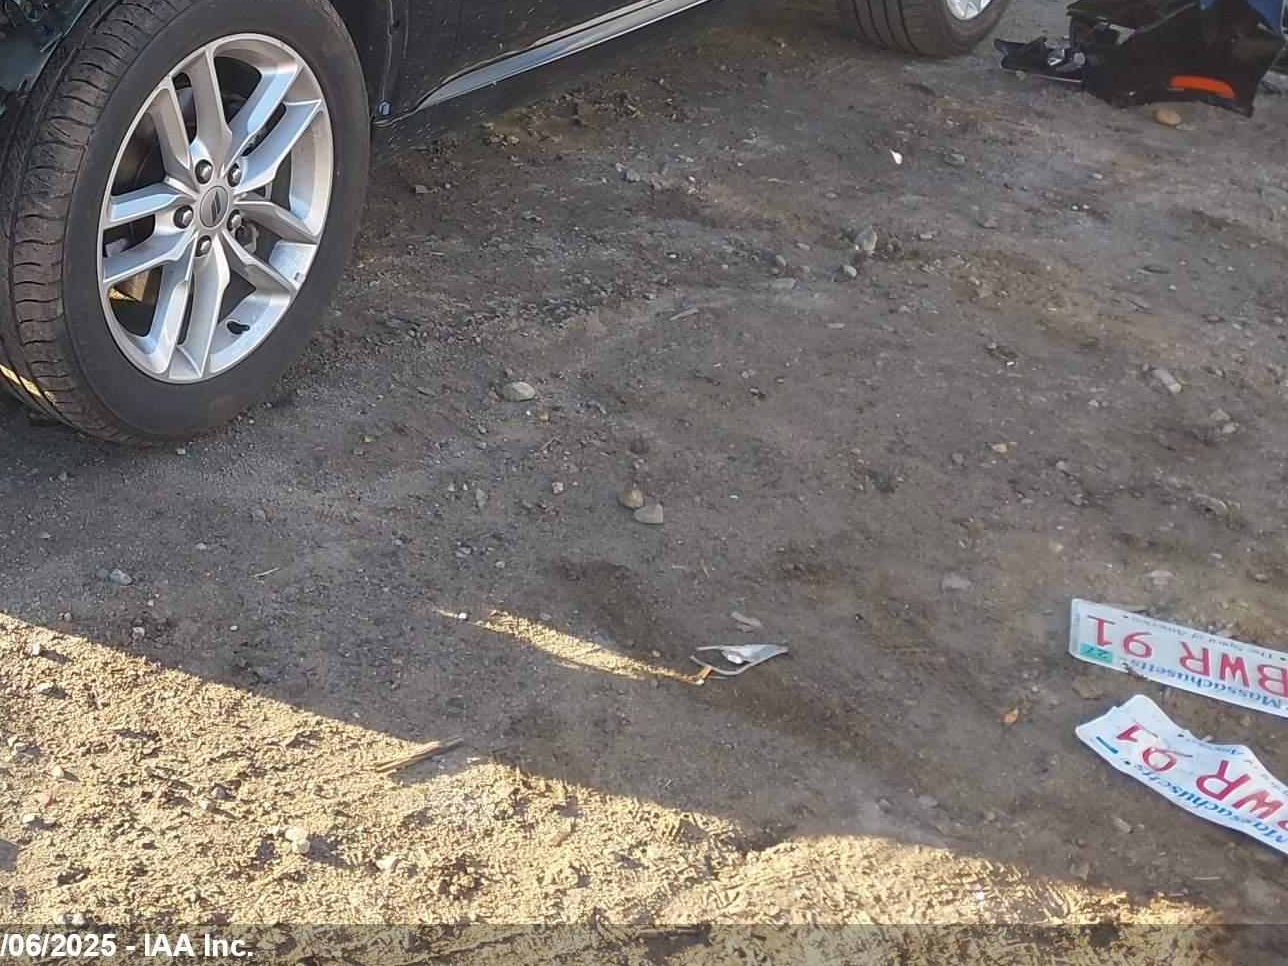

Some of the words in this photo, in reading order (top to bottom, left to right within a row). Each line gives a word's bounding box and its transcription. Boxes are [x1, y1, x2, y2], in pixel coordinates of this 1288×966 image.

[1087, 615, 1153, 659] 91
[1127, 658, 1282, 710] Massachusetts
[1133, 763, 1287, 844] Massachusetts
[1195, 760, 1288, 831] WR
